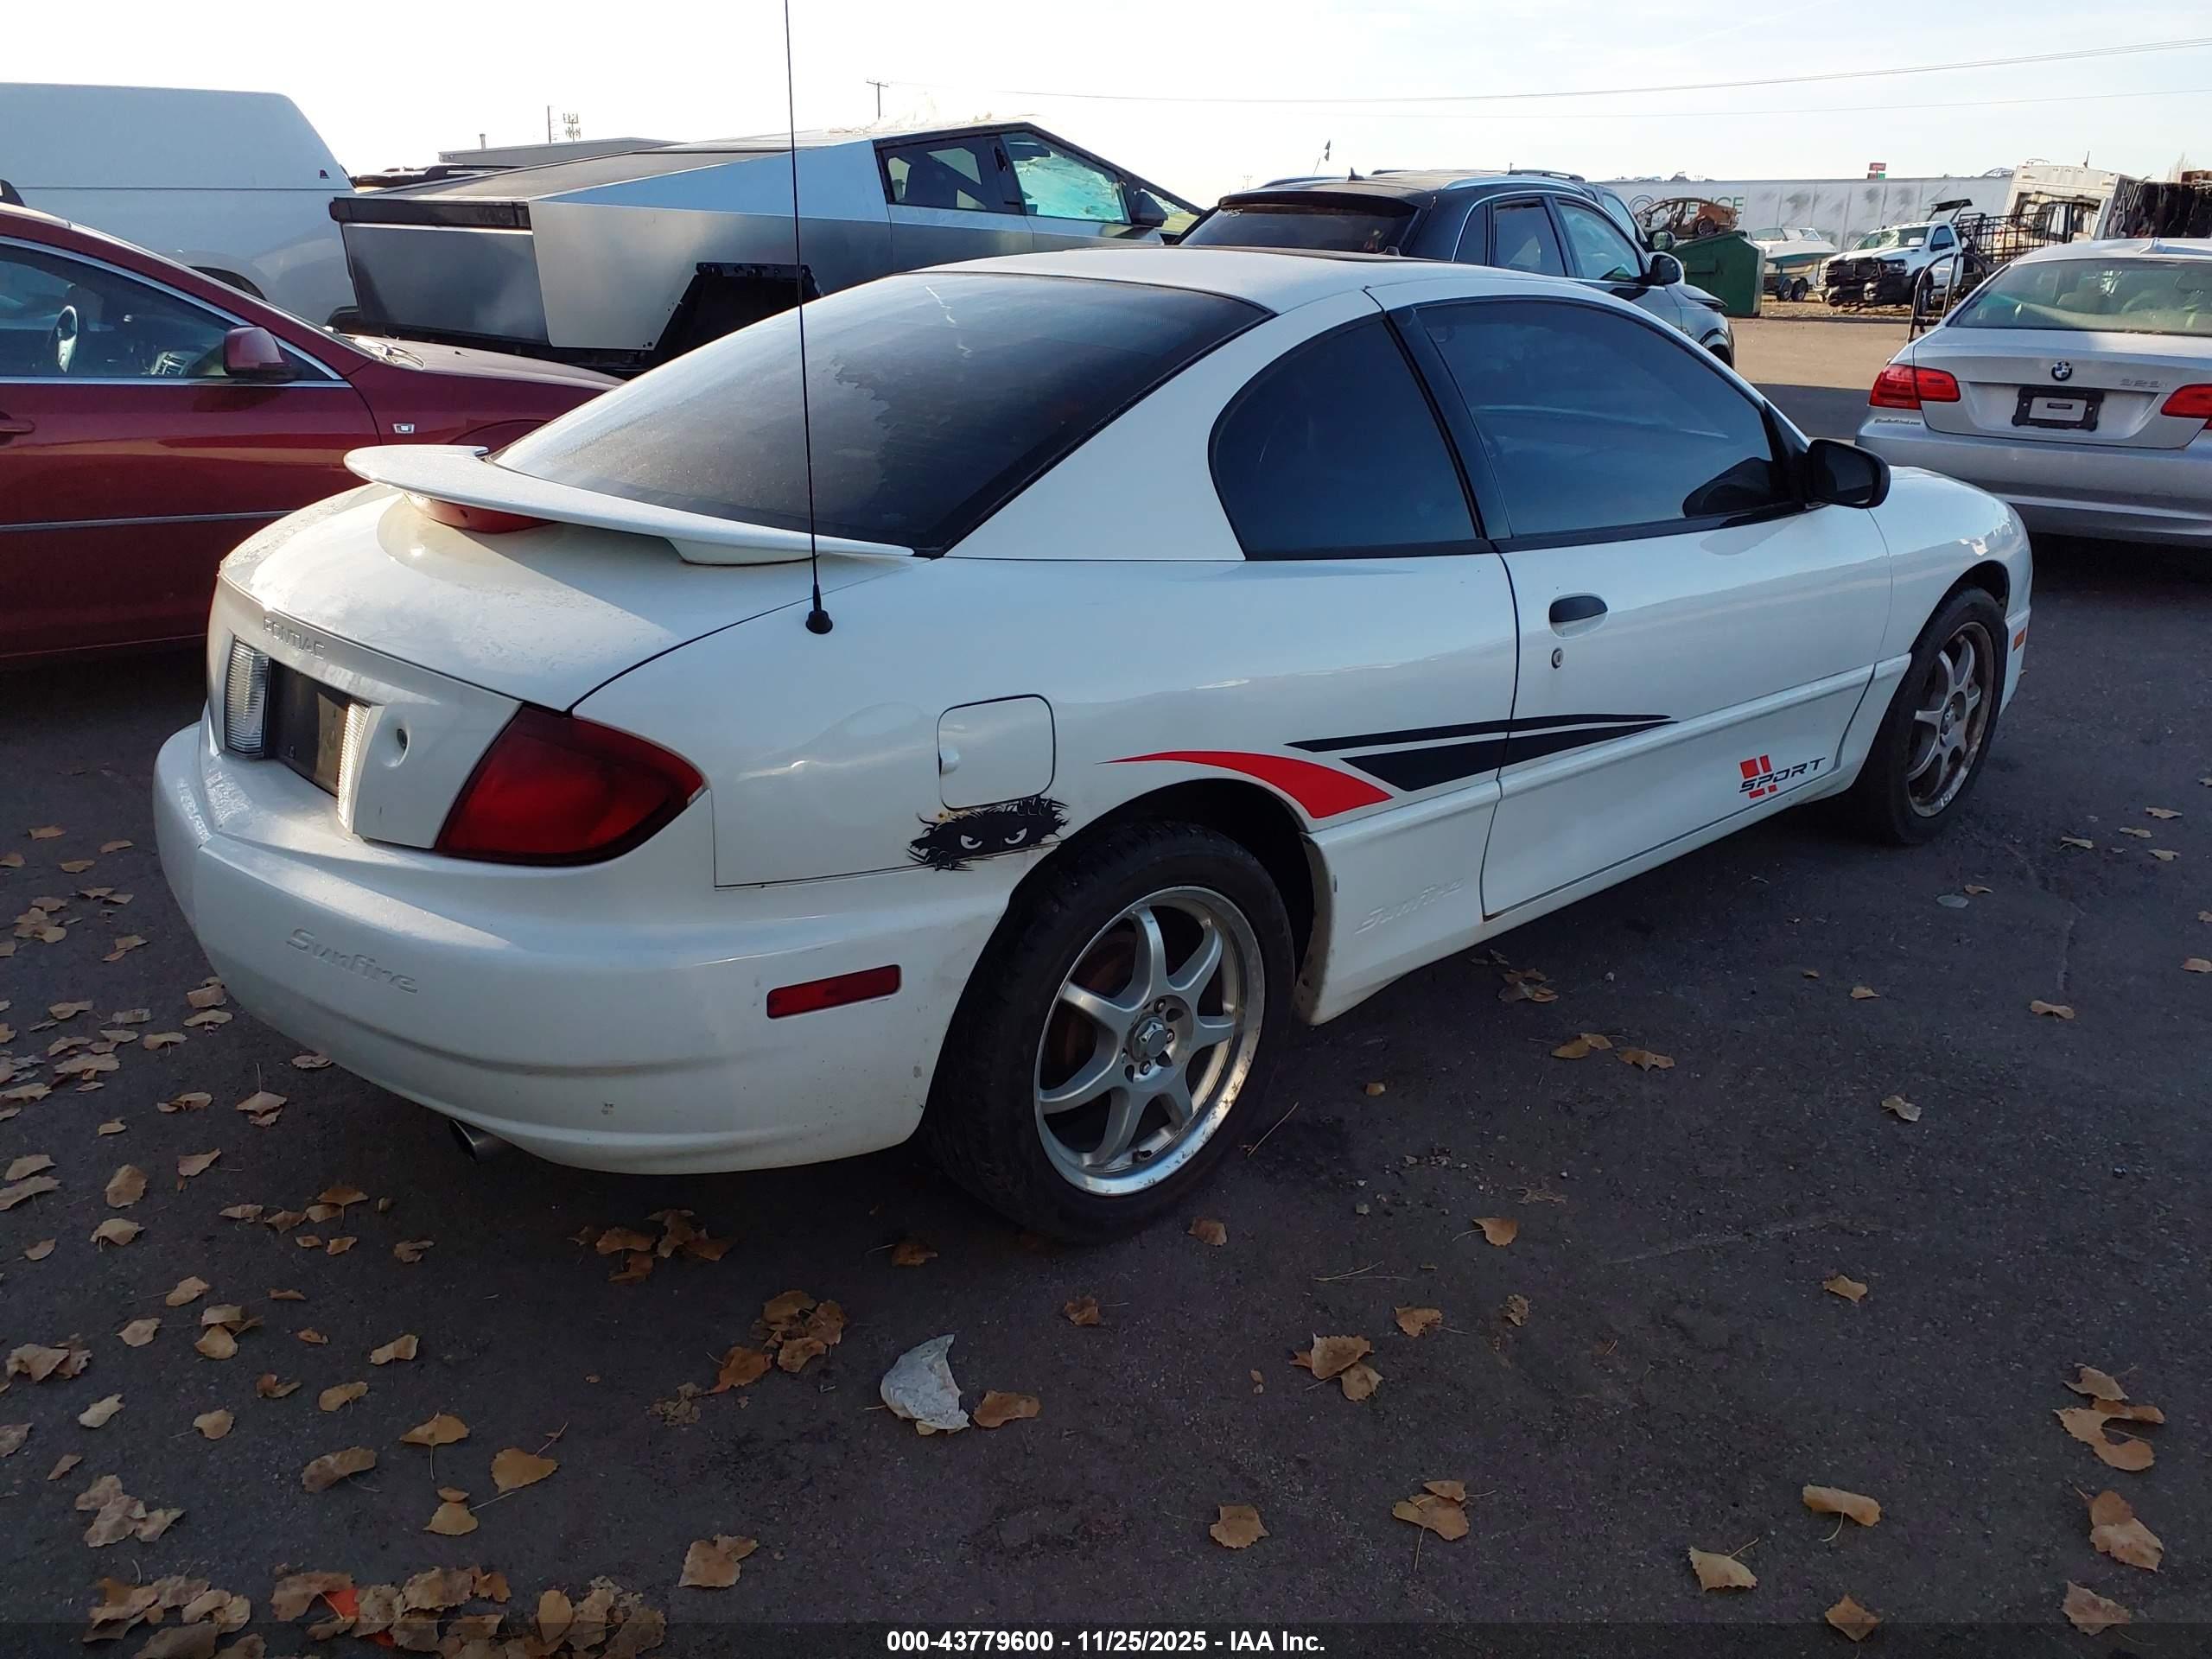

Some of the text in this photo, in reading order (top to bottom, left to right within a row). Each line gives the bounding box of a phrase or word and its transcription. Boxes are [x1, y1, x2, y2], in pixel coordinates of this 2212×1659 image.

[263, 616, 326, 660] PONTIAC
[1738, 757, 1826, 793] SPORT
[285, 927, 419, 995] Sunfire
